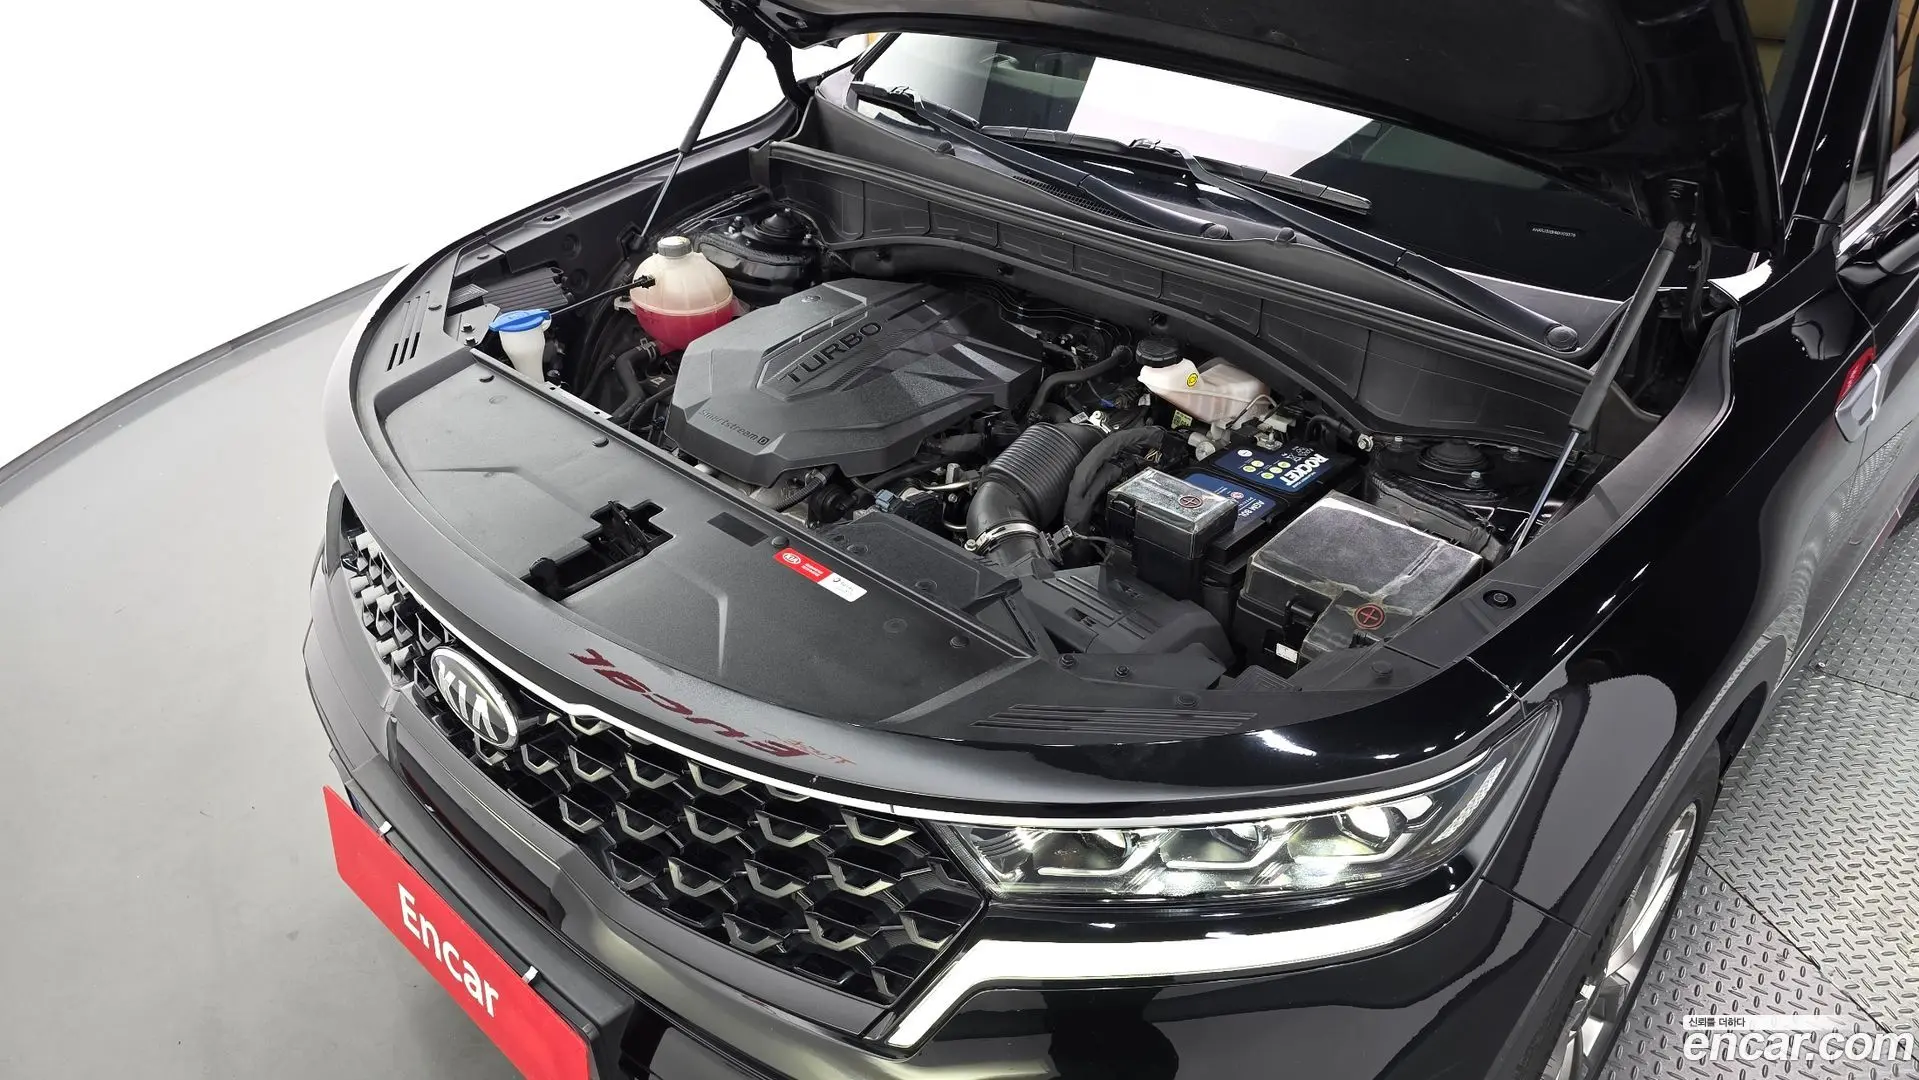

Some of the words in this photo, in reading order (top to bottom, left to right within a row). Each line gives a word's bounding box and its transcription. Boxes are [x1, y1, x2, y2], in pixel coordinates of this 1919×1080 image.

[778, 321, 882, 383] TURBO
[1280, 453, 1329, 486] ROCKET
[435, 658, 499, 742] KIA
[398, 882, 499, 1018] Encar
